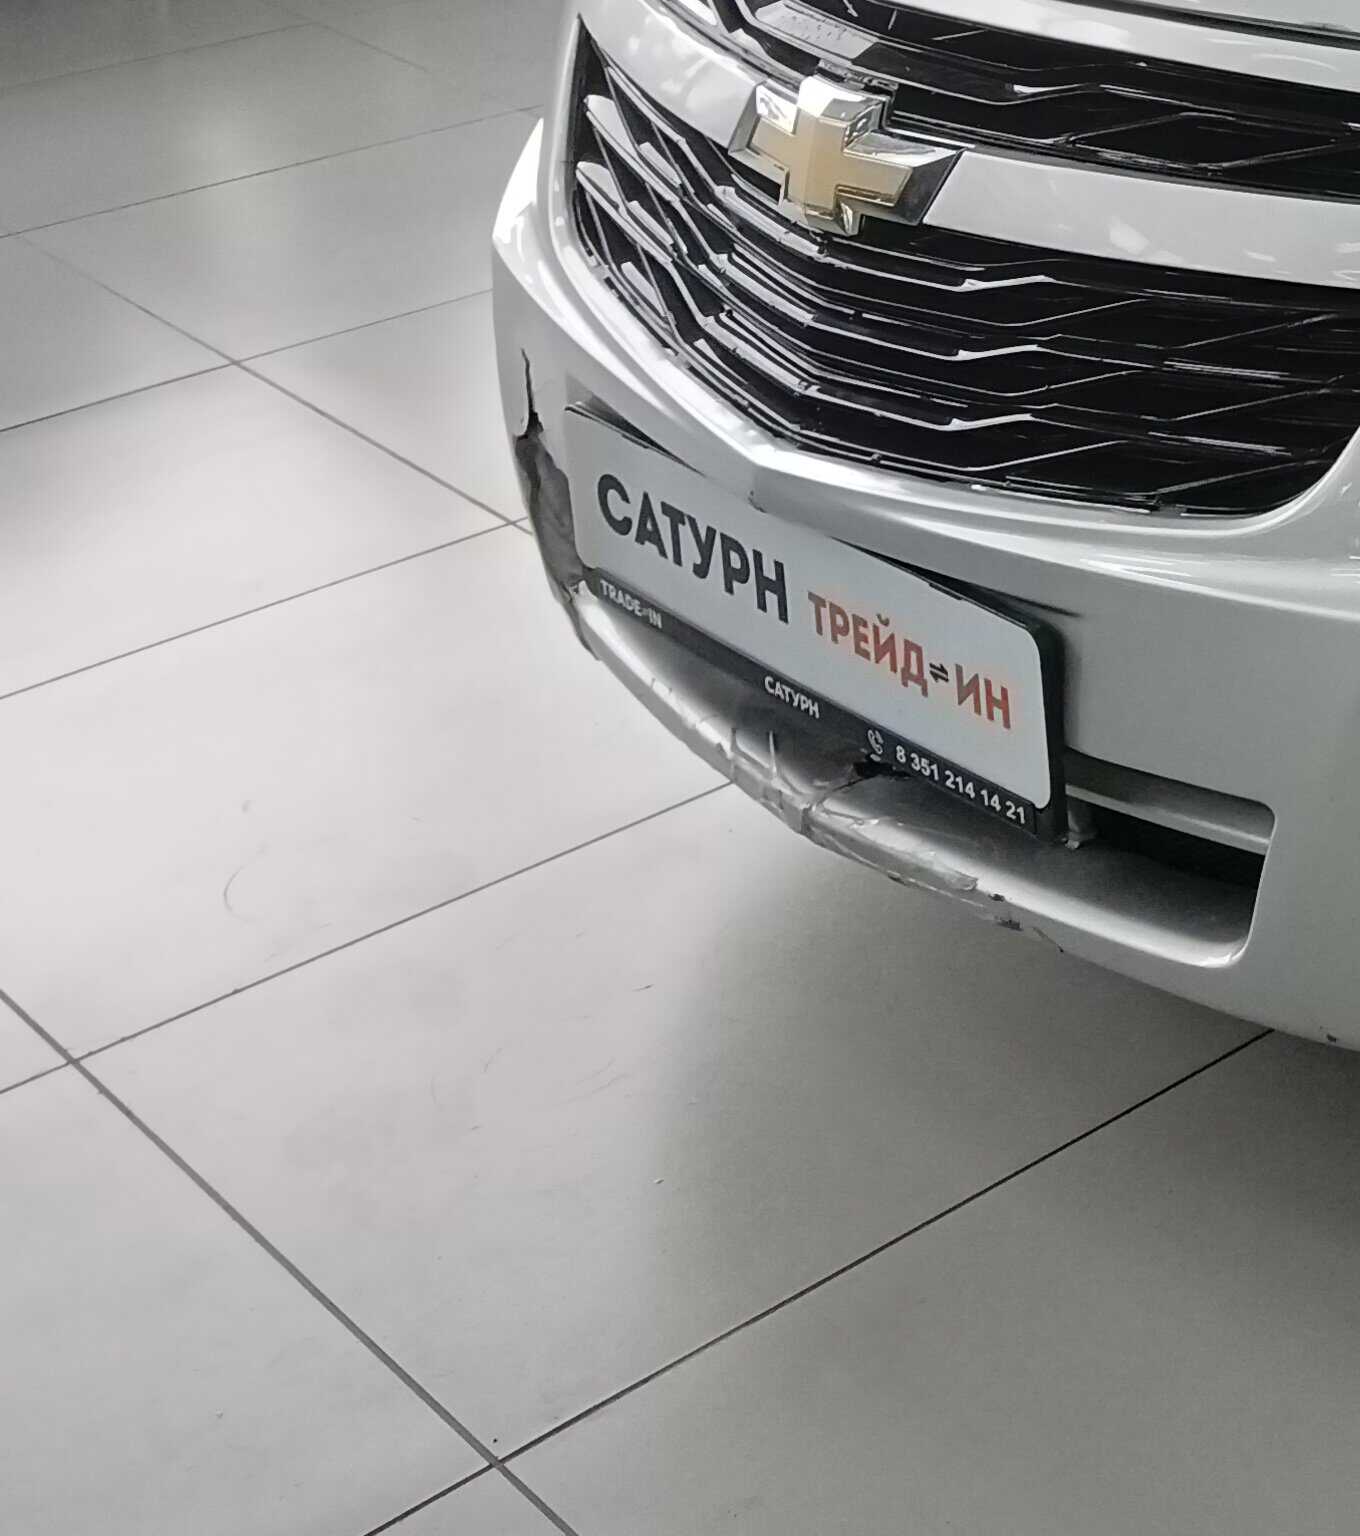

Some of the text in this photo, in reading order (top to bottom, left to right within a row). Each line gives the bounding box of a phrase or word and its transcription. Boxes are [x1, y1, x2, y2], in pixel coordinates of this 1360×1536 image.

[597, 473, 789, 625] САТУРН
[764, 675, 820, 719] САТУРН
[895, 744, 1026, 824] 8 351 214 14 21
